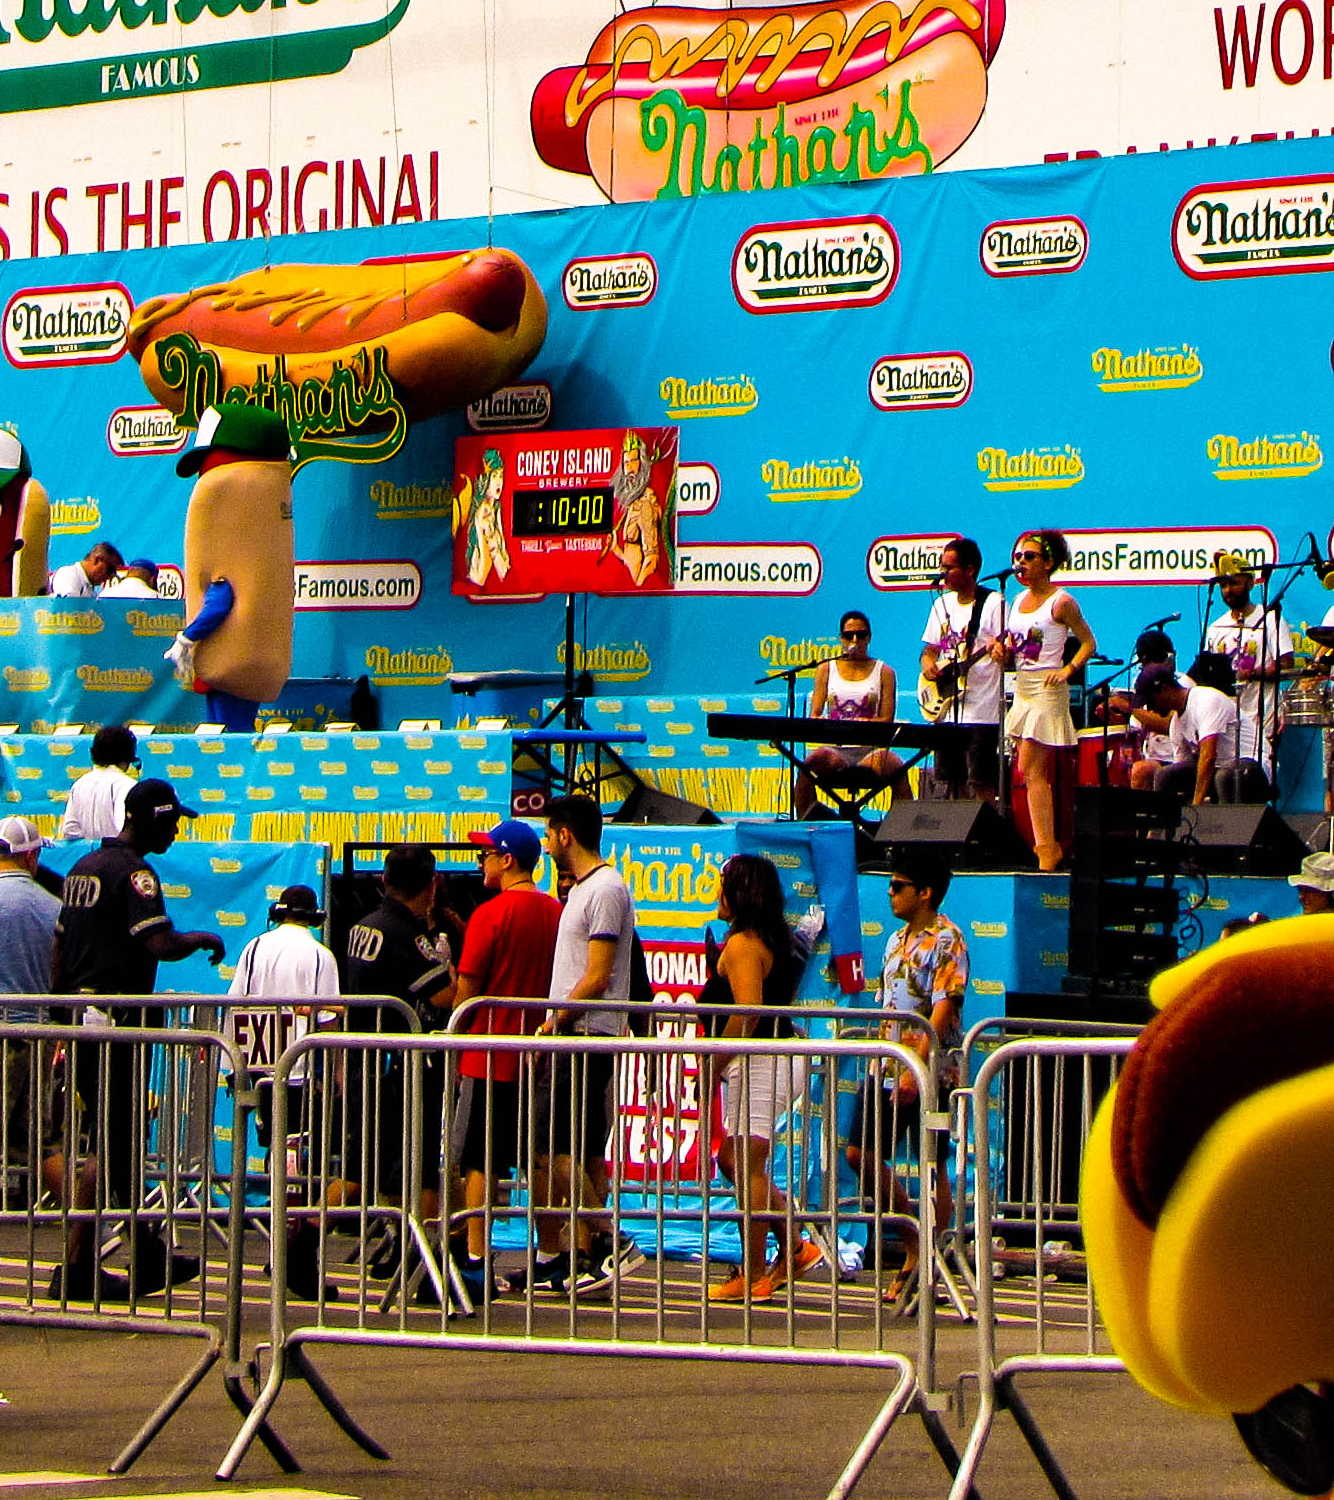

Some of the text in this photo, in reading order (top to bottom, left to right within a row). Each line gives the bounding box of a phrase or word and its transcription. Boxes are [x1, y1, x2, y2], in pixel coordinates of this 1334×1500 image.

[100, 53, 202, 95] FAMOUS
[30, 186, 70, 258] IS
[77, 176, 184, 253] THE
[745, 231, 888, 283] Nathan's
[987, 225, 1080, 259] Nathan's
[568, 263, 651, 295] Nathan's
[12, 297, 126, 343] Nathan's
[877, 361, 966, 393] Nathan's
[1091, 343, 1205, 382] Nathan's
[517, 447, 613, 477] CONEY ISLAND
[977, 444, 1086, 481] Nathan's
[1206, 430, 1324, 471] Nathan's
[538, 477, 590, 489] BREWERY
[761, 456, 863, 492] Nathan's
[233, 1018, 295, 1068] EXIT
